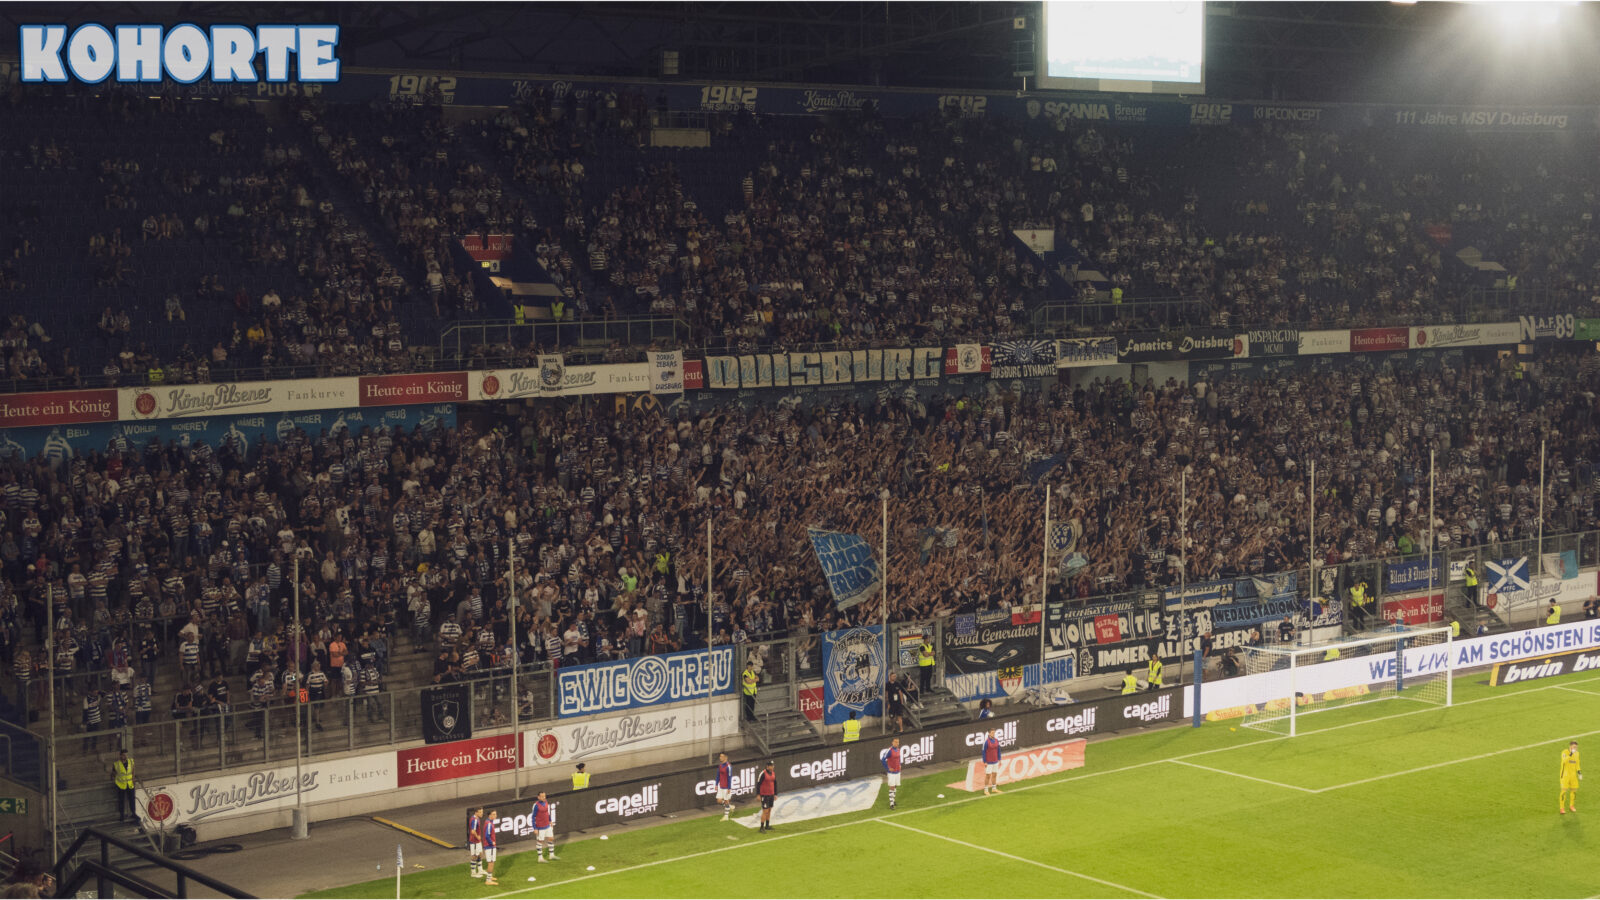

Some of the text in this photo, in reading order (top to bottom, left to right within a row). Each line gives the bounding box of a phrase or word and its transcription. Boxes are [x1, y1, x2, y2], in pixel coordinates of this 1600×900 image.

[257, 83, 298, 97] PLUS
[701, 87, 758, 105] 1902
[1044, 102, 1109, 120] SCANIA
[1114, 104, 1147, 116] Breuer
[1190, 104, 1232, 120] 1902
[1394, 111, 1568, 128] 111 Jahre MSV Duisburg
[166, 384, 273, 413] König Pilsener
[287, 389, 346, 401] Fankurve
[366, 379, 463, 398] Heute ein König
[42, 402, 65, 414] ein
[69, 398, 112, 417] König
[945, 631, 979, 646] Proud
[981, 624, 1039, 645] Generation
[1049, 612, 1161, 647] KOHRTE
[1098, 644, 1151, 668] IMMER
[1369, 657, 1413, 680] WEL
[1458, 644, 1484, 665] AM
[1490, 627, 1584, 659] SCHÖNSTEN
[559, 648, 733, 715] EWIG TREU
[1503, 659, 1564, 684] bwin
[800, 698, 822, 711] Heu
[1123, 694, 1170, 720] capelli
[1046, 707, 1096, 733] capelli
[1144, 711, 1170, 721] SPORT
[569, 716, 677, 754] König Pilsener
[965, 720, 1017, 747] caelli
[1068, 724, 1095, 735] SPORT
[407, 746, 517, 774] Heute ein König
[790, 750, 847, 780] capelli
[904, 754, 935, 765] SPORT
[998, 748, 1065, 783] ZOXS
[328, 767, 390, 785] Fankurve
[695, 767, 757, 796] caelli
[805, 768, 847, 781] SPORT
[188, 771, 320, 815] König Pilsener
[595, 784, 659, 816] capelli
[624, 803, 659, 817] SPORT
